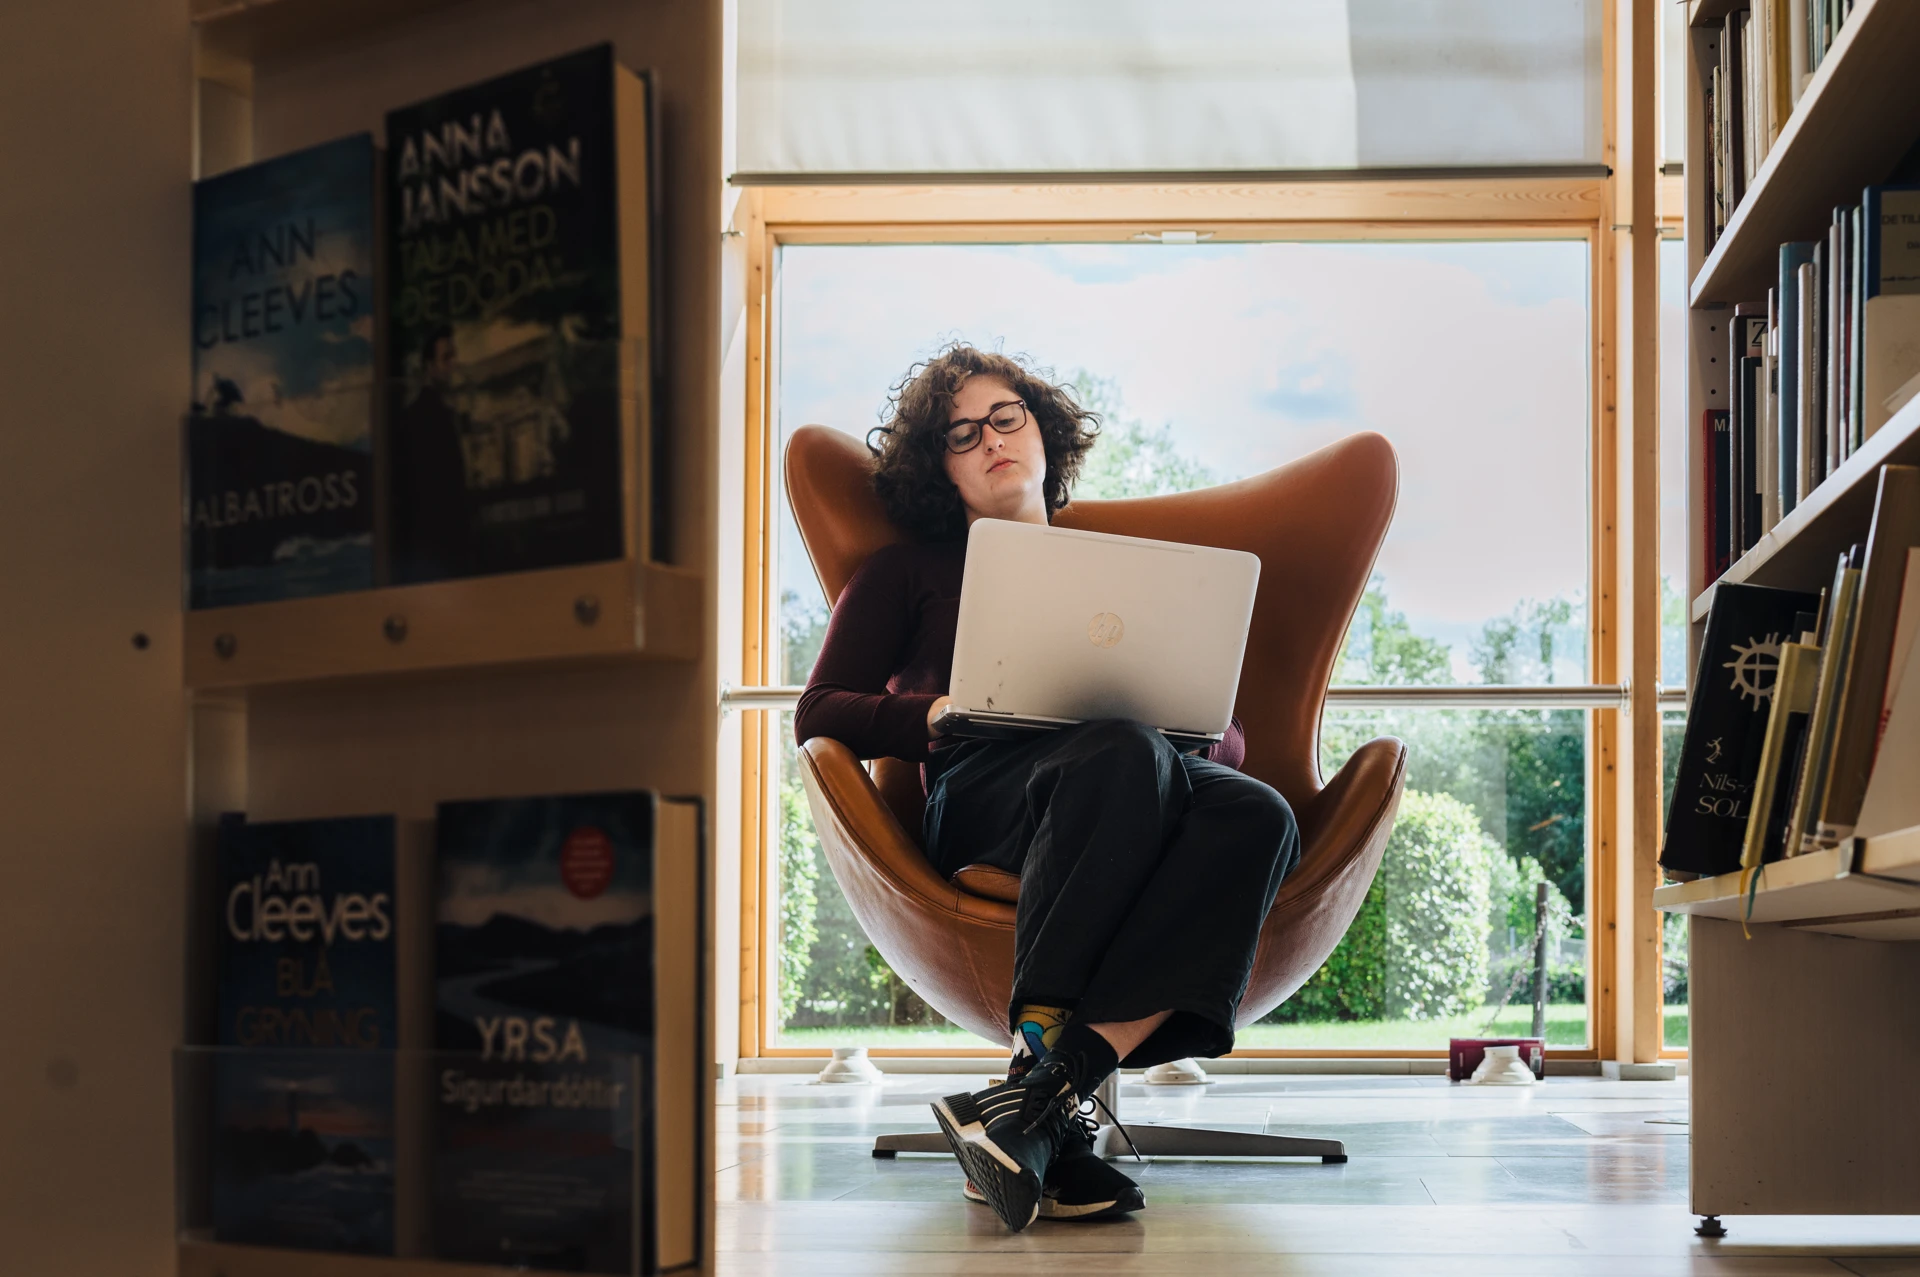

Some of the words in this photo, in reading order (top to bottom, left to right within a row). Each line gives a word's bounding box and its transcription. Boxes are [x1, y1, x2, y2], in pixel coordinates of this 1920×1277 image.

[398, 107, 511, 187] ANNA
[398, 136, 582, 235] JANSSON
[229, 217, 315, 279] ANN
[477, 204, 557, 262] MED
[194, 269, 360, 349] CLEEVES
[1714, 418, 1730, 431] M
[193, 470, 359, 529] ALBATROSS
[226, 874, 392, 946] Cleeves
[235, 1004, 382, 1050] GRYNING
[474, 1015, 588, 1063] YRSA
